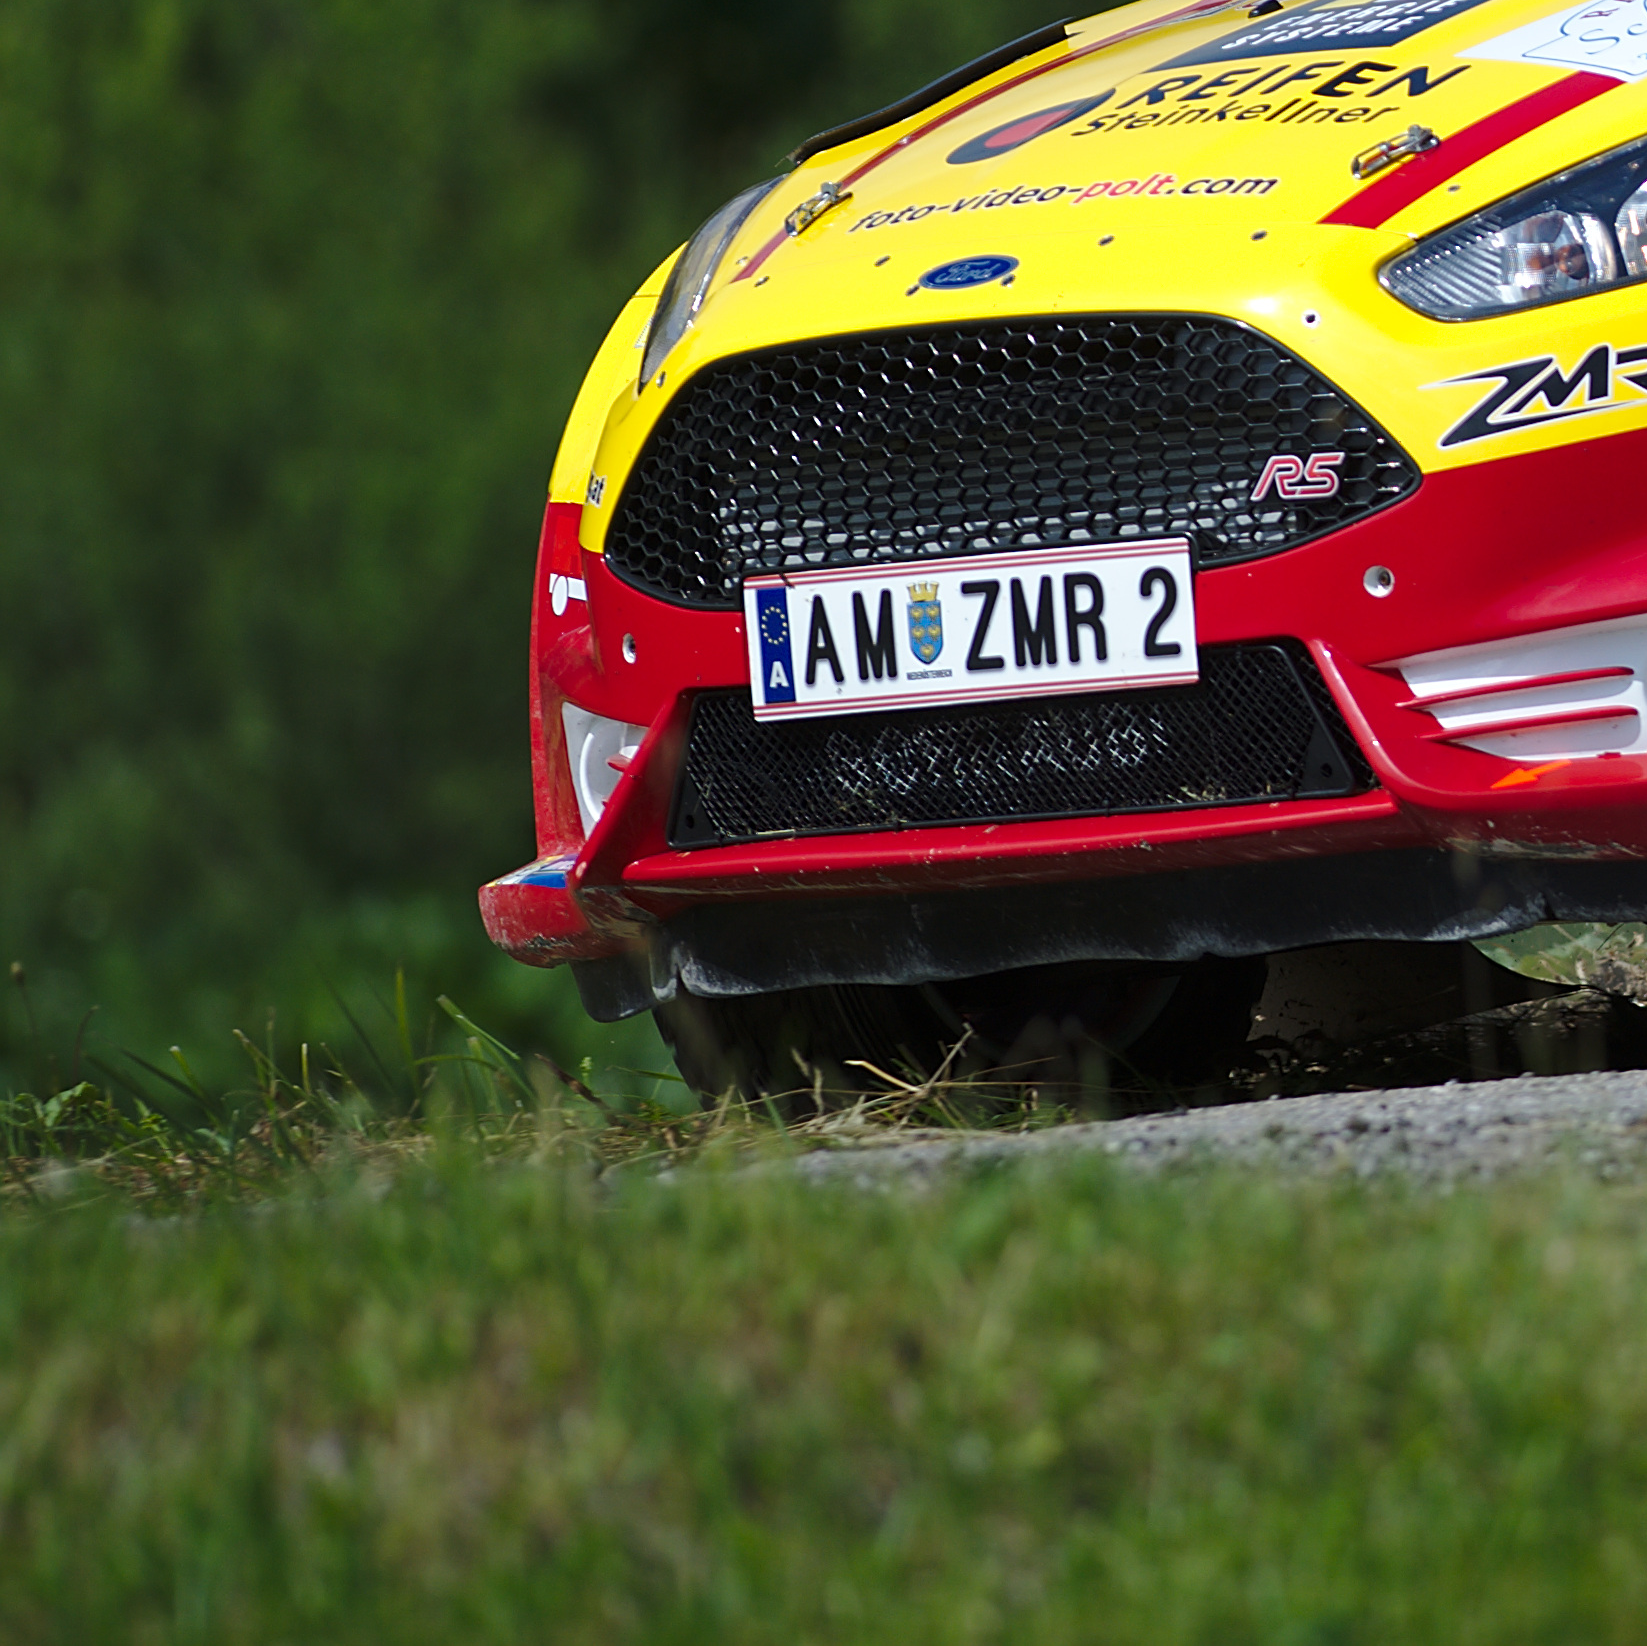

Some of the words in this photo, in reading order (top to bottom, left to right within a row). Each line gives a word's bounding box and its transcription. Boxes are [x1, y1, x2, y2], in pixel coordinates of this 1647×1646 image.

[1221, 14, 1425, 50] SYSTEME
[1115, 59, 1472, 110] REIFEN
[848, 173, 1279, 234] foto-video-polt.com
[805, 588, 898, 685] AM
[960, 571, 1109, 671] ZMR
[1139, 566, 1182, 657] 2
[768, 660, 790, 689] A
